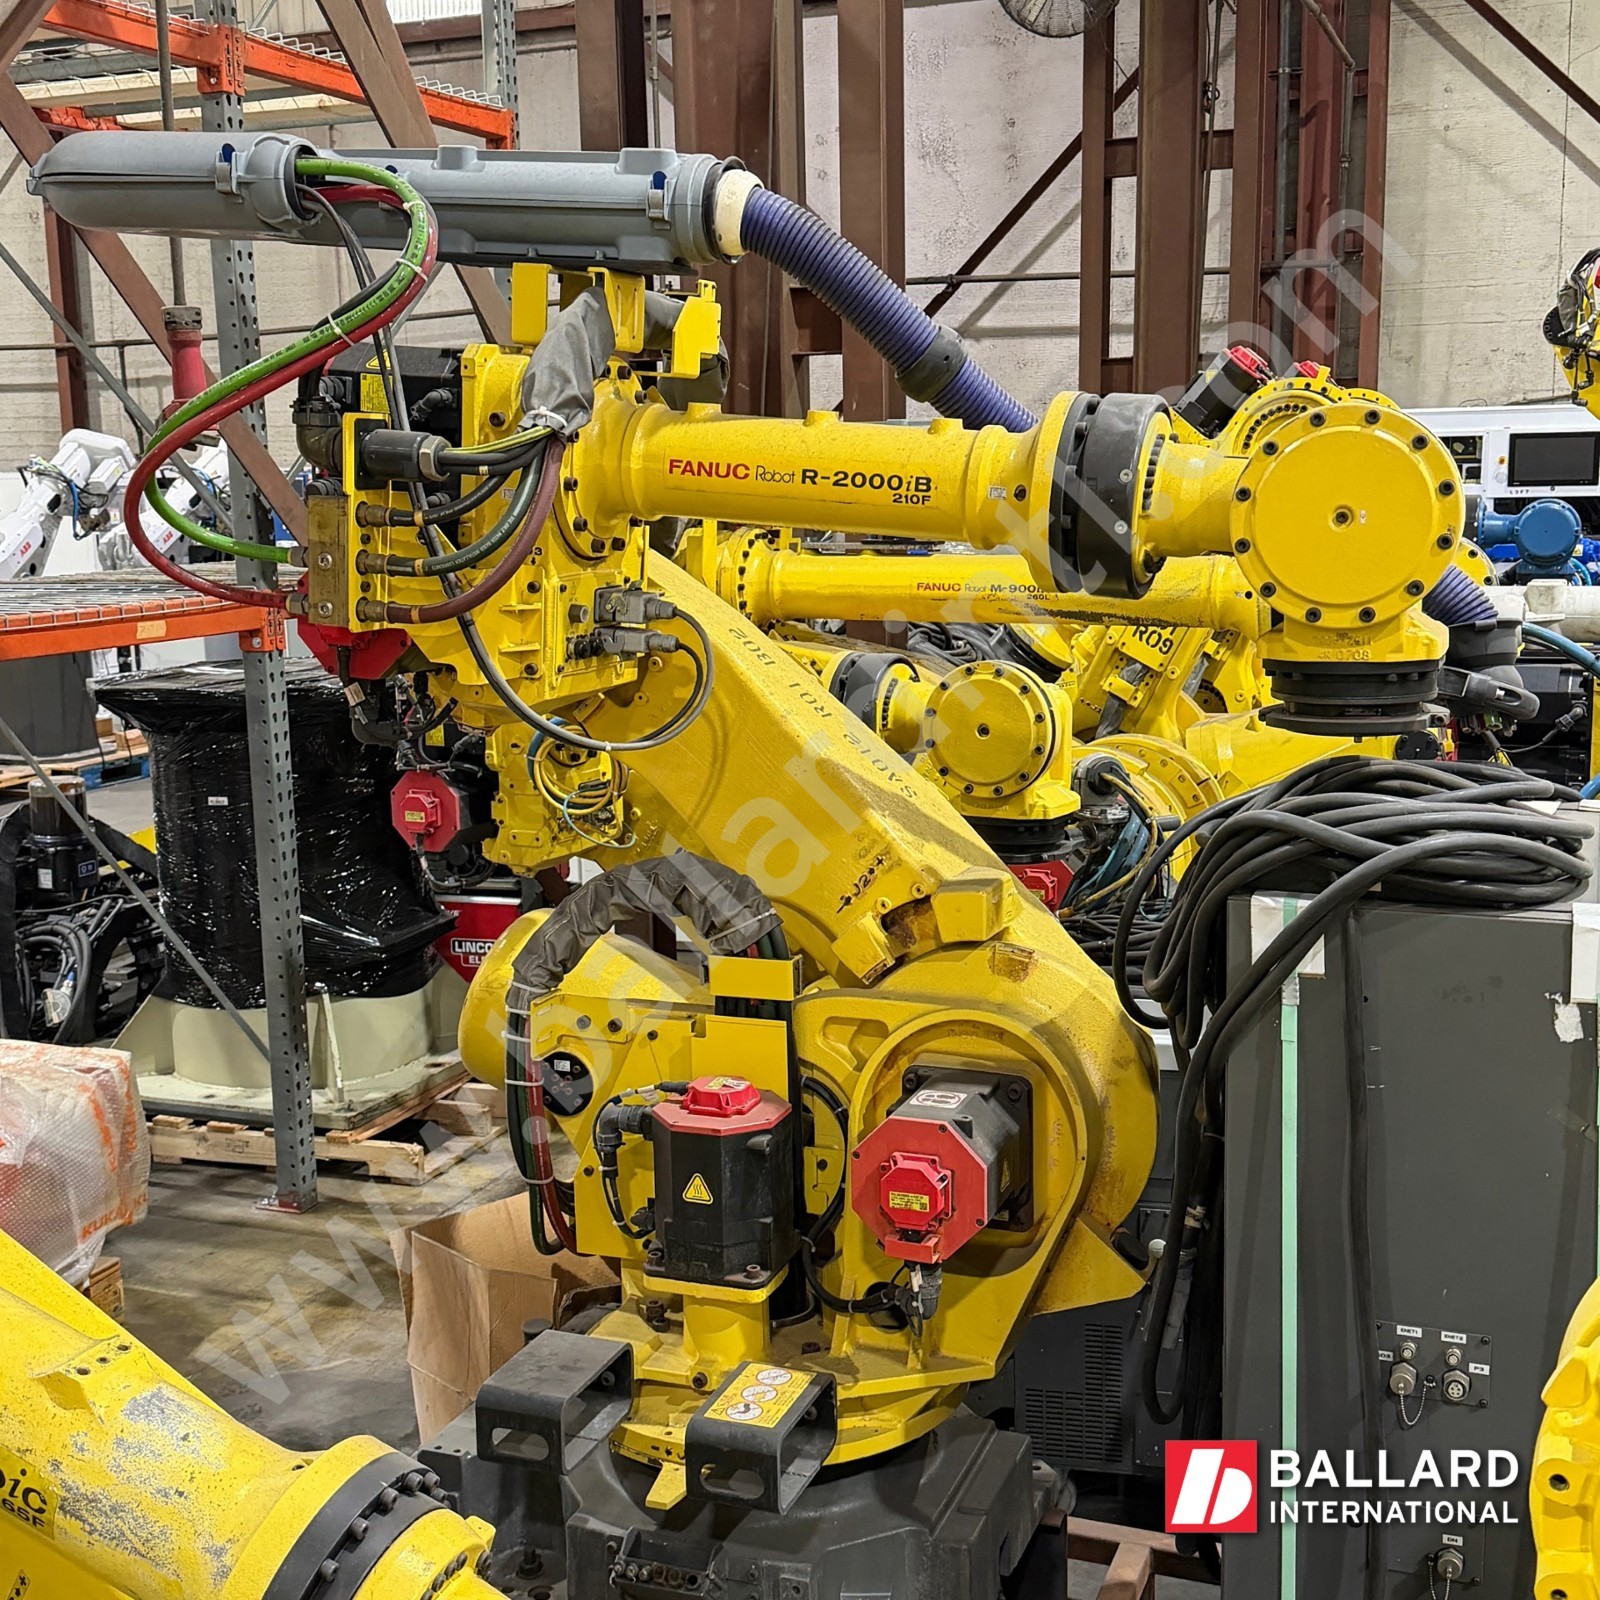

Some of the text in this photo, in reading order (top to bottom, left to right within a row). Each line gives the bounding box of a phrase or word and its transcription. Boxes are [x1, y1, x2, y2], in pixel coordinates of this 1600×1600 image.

[669, 459, 932, 493] FANUC Robot R-2000iB
[892, 494, 931, 506] 210F
[162, 530, 174, 544] ABB
[19, 541, 32, 557] ABB
[917, 582, 961, 592] FANUC
[1026, 593, 1050, 601] 260L
[788, 682, 832, 718] R01
[851, 873, 872, 898] J2
